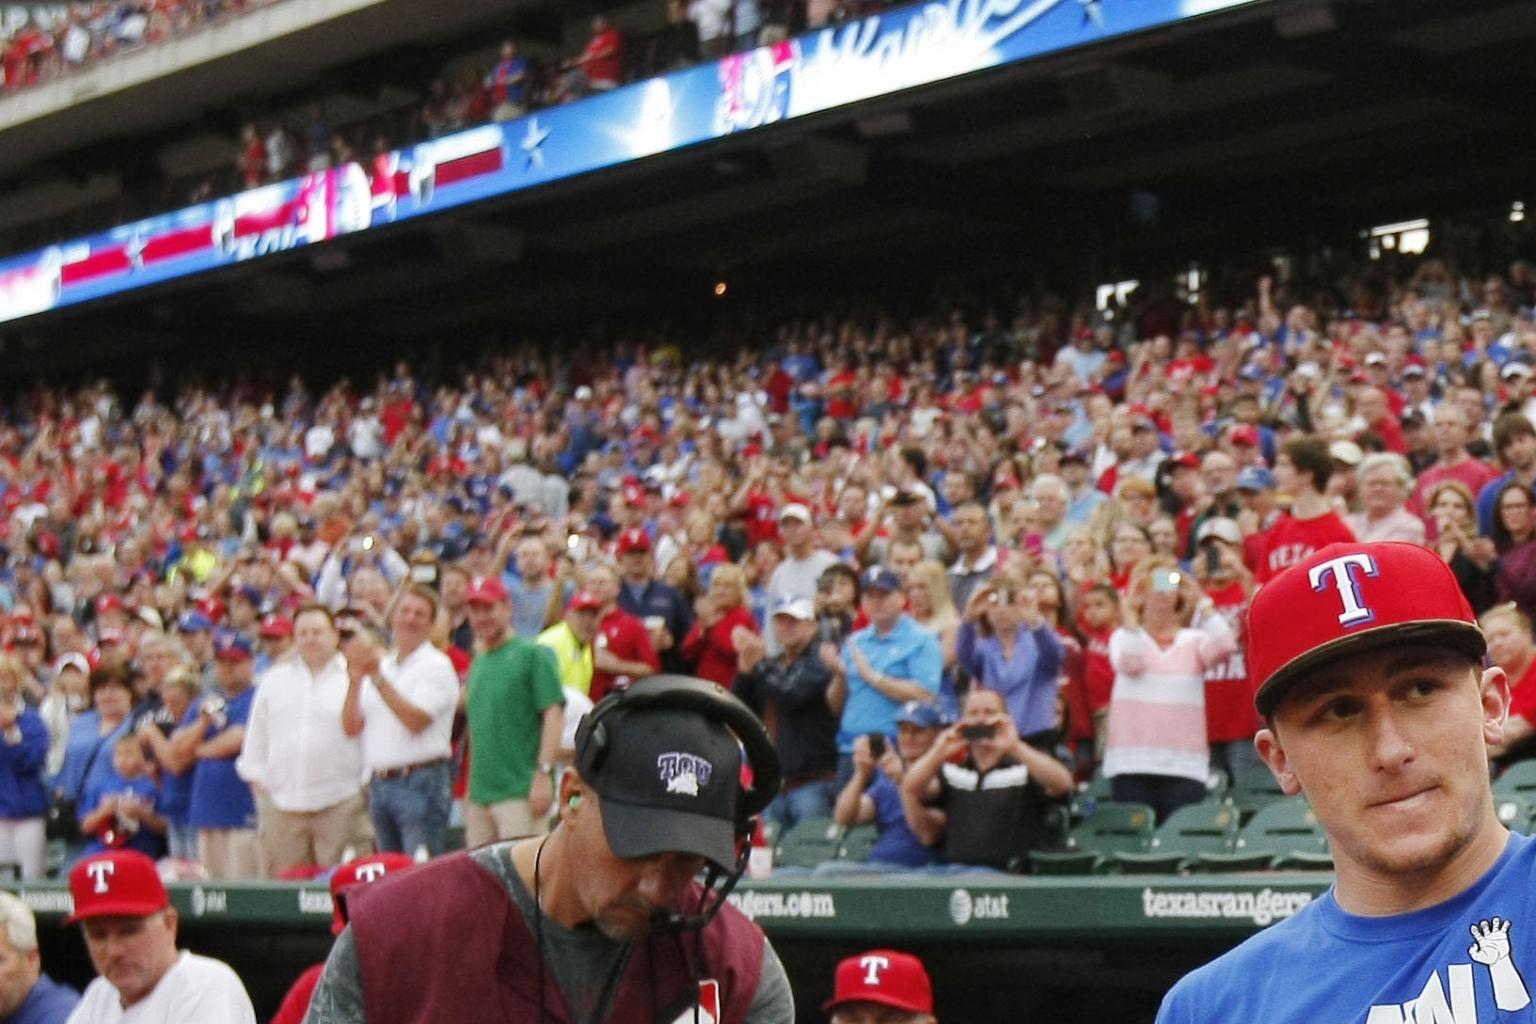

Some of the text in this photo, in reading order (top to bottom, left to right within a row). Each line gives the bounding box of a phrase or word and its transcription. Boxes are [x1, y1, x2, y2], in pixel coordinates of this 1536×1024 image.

[1308, 553, 1380, 628] T
[87, 860, 115, 894] T
[973, 894, 1010, 919] at&t
[860, 956, 889, 985] T
